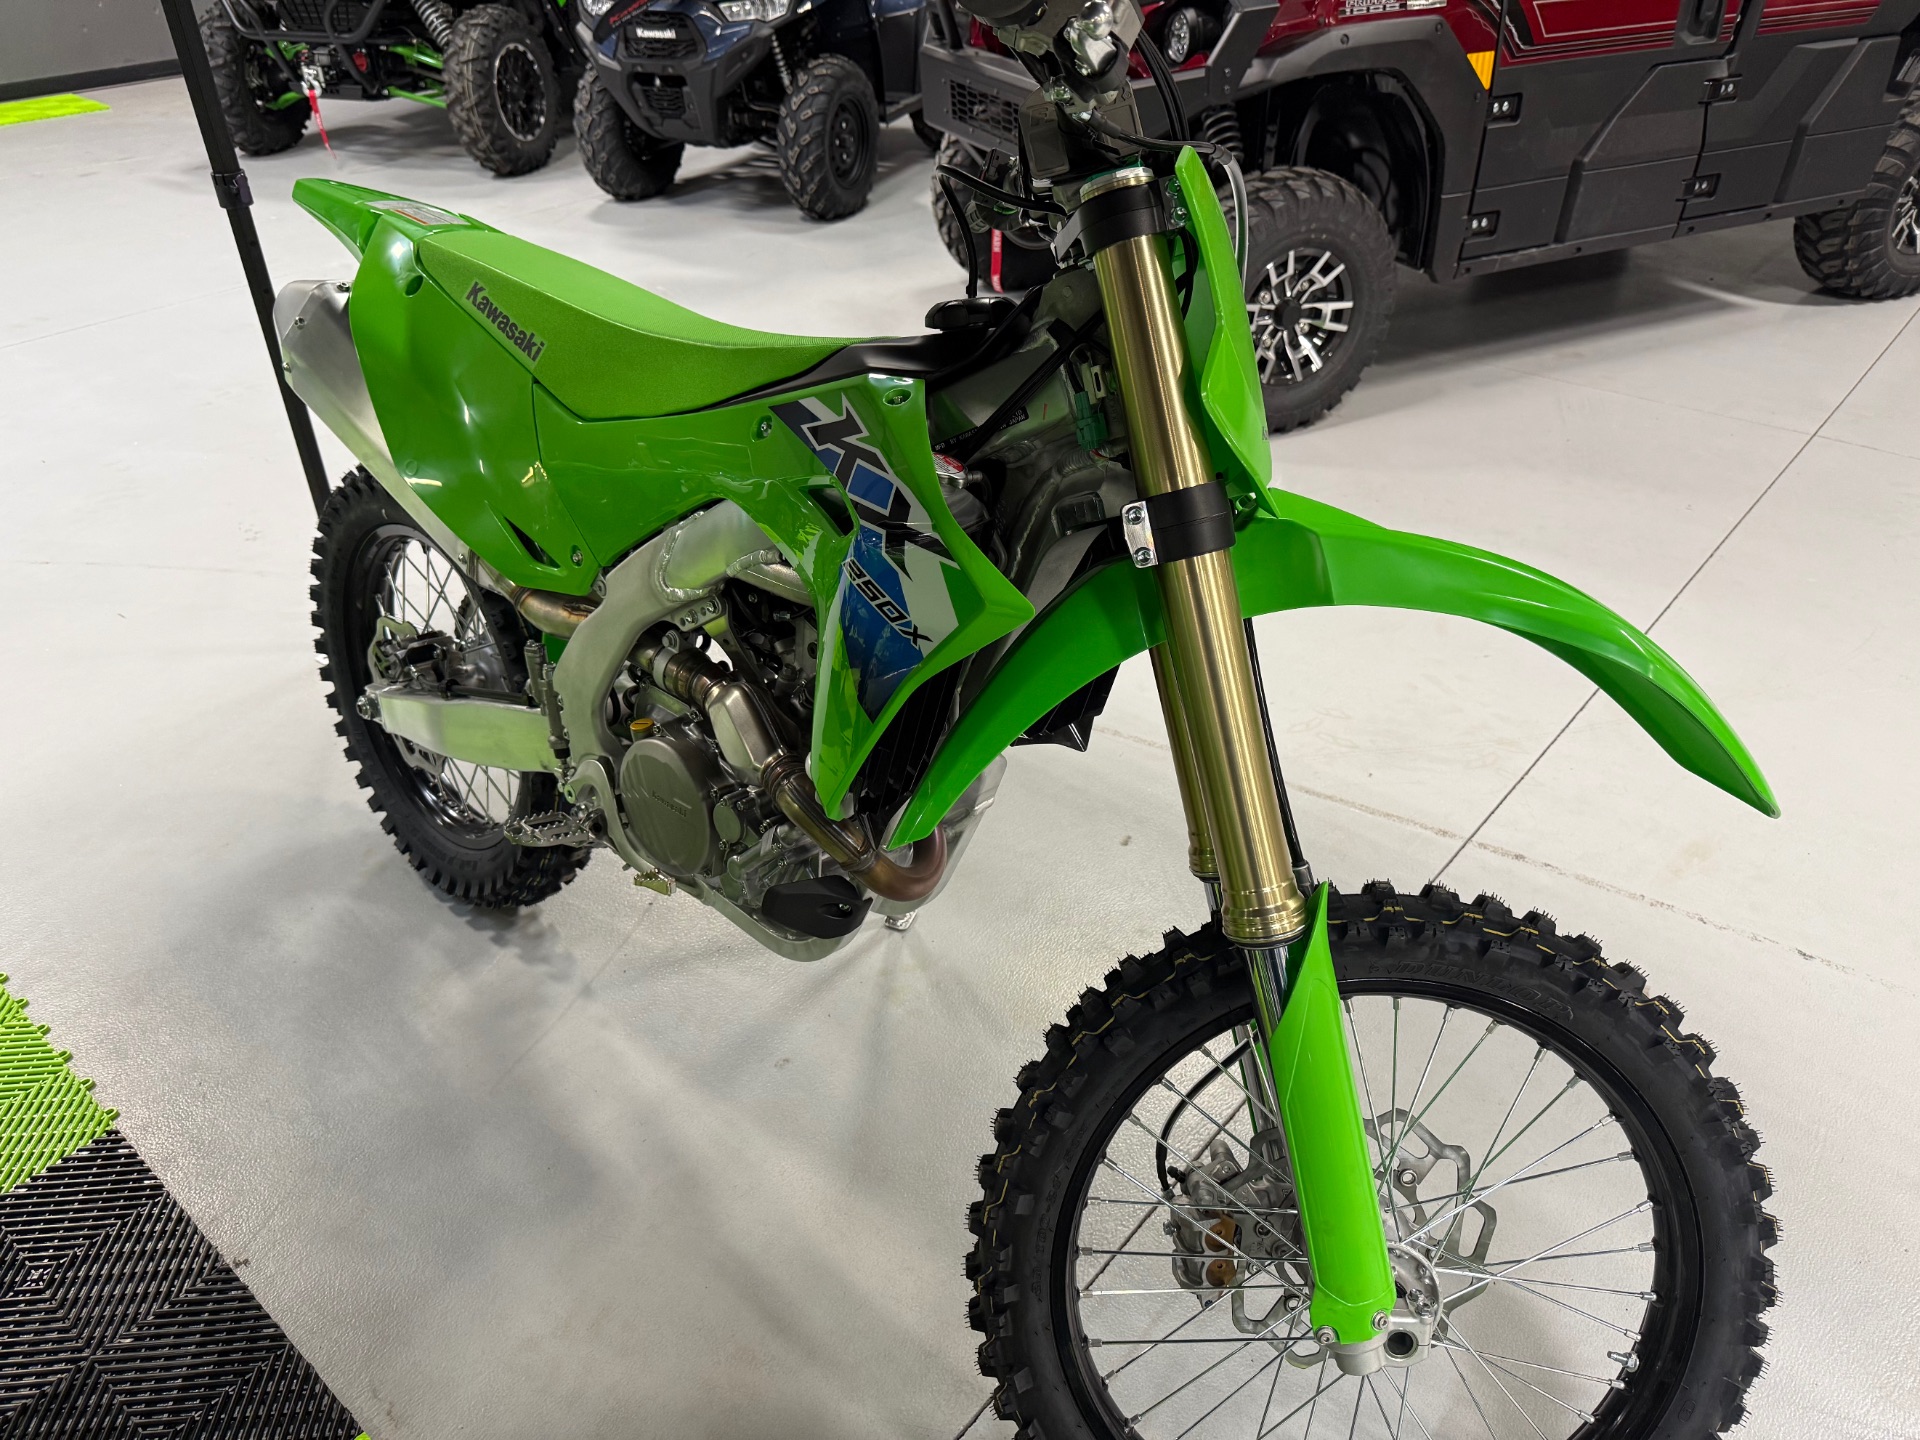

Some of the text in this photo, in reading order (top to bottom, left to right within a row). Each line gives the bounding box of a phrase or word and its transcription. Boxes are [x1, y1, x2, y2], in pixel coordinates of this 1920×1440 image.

[465, 281, 546, 362] Kawasaki
[802, 393, 960, 583] KX
[841, 556, 934, 647] 250X
[1393, 959, 1574, 1022] DUNLOP
